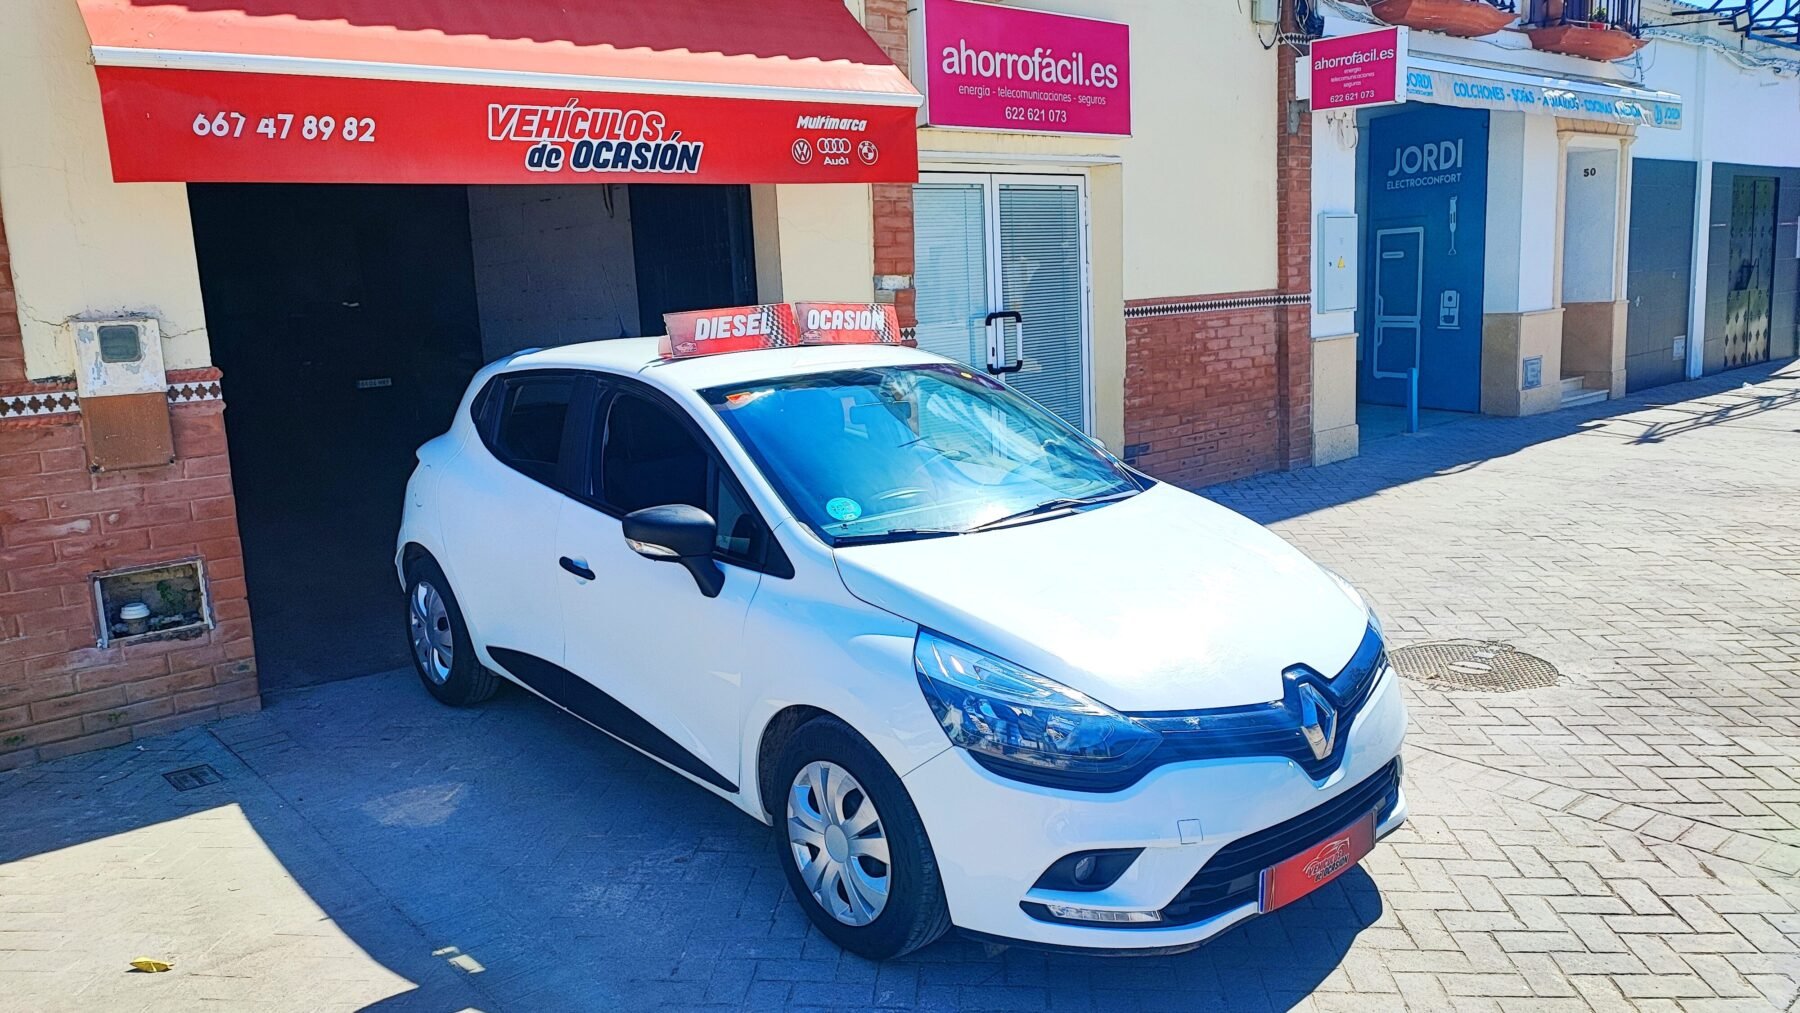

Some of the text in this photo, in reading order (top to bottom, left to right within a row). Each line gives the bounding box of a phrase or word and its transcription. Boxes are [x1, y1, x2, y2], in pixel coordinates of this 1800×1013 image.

[942, 39, 1118, 89] ahorrofácil.es
[1314, 48, 1394, 71] ahorrofácil.es
[997, 86, 1072, 103] telecomunicaciones
[1078, 95, 1107, 107] seguros
[1330, 90, 1375, 103] 622 621 073
[1453, 81, 1505, 101] COLCHONES
[487, 98, 666, 143] VEHÍCULOS
[796, 115, 868, 131] Multimarca
[1005, 106, 1067, 123] 622 621 073
[192, 112, 376, 142] 667 47 89 82
[526, 132, 703, 173] de OCASIÓN
[823, 156, 850, 166] Audi
[1387, 138, 1463, 178] JORDI
[1386, 172, 1462, 190] ELECTROCONFORT
[1583, 167, 1597, 178] 50
[695, 312, 772, 341] DIESEL
[807, 309, 884, 331] OCASION
